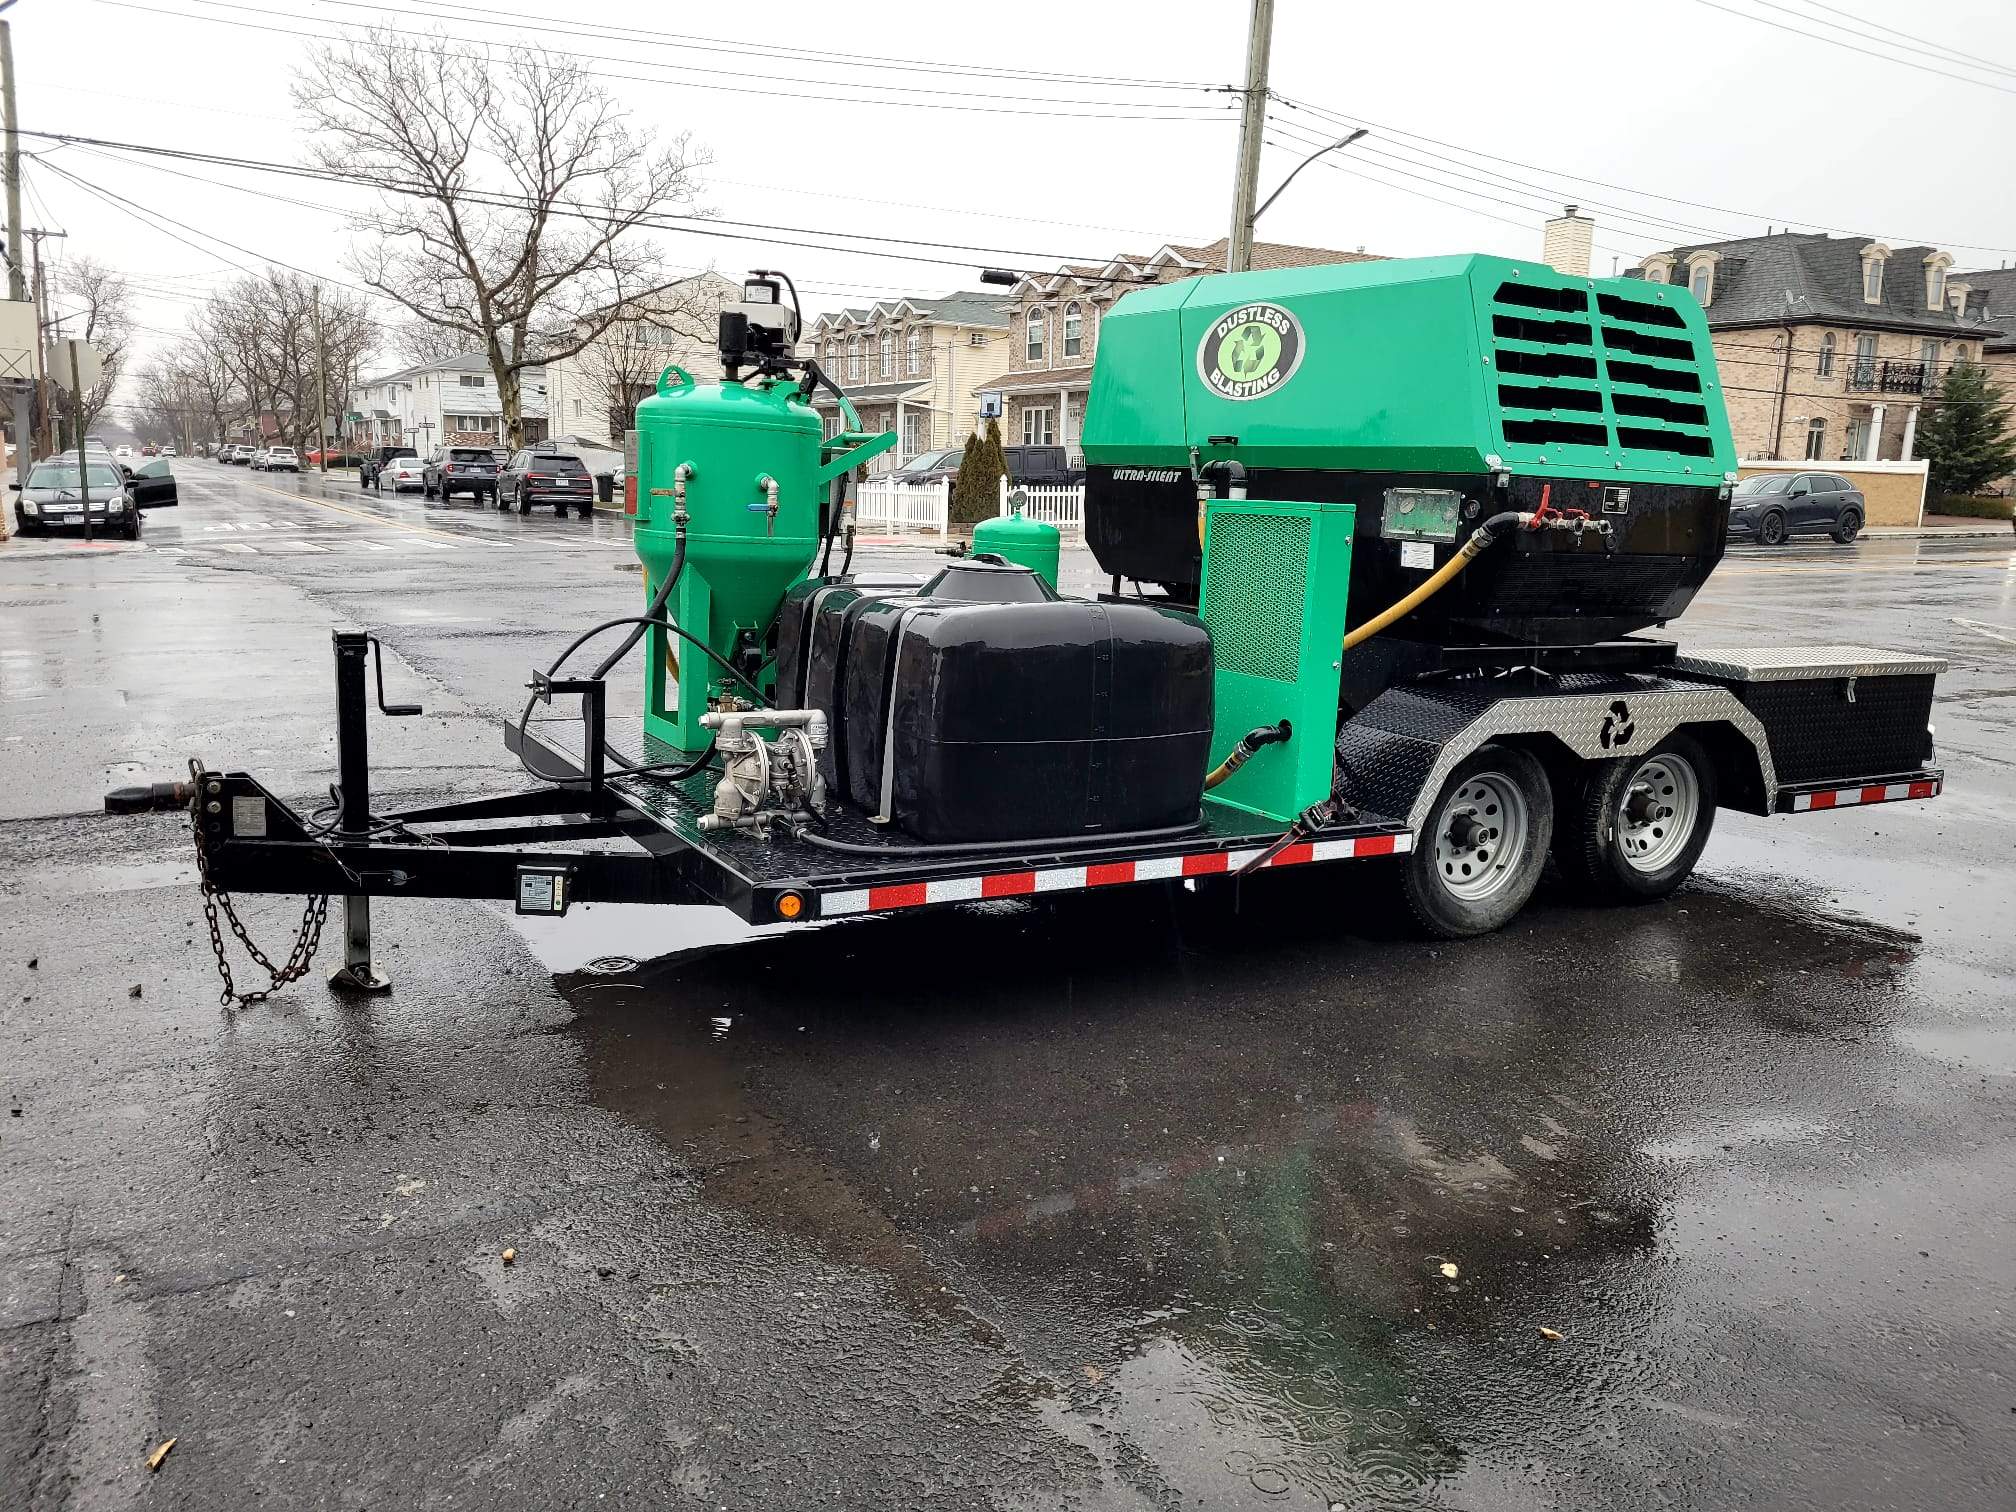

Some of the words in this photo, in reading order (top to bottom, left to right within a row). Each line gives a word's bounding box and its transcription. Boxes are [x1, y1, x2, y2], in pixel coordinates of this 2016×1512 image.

[1217, 307, 1290, 339] DUSTLESS
[1210, 367, 1281, 397] BLASTING
[1113, 469, 1181, 483] ULTRA-SILENT
